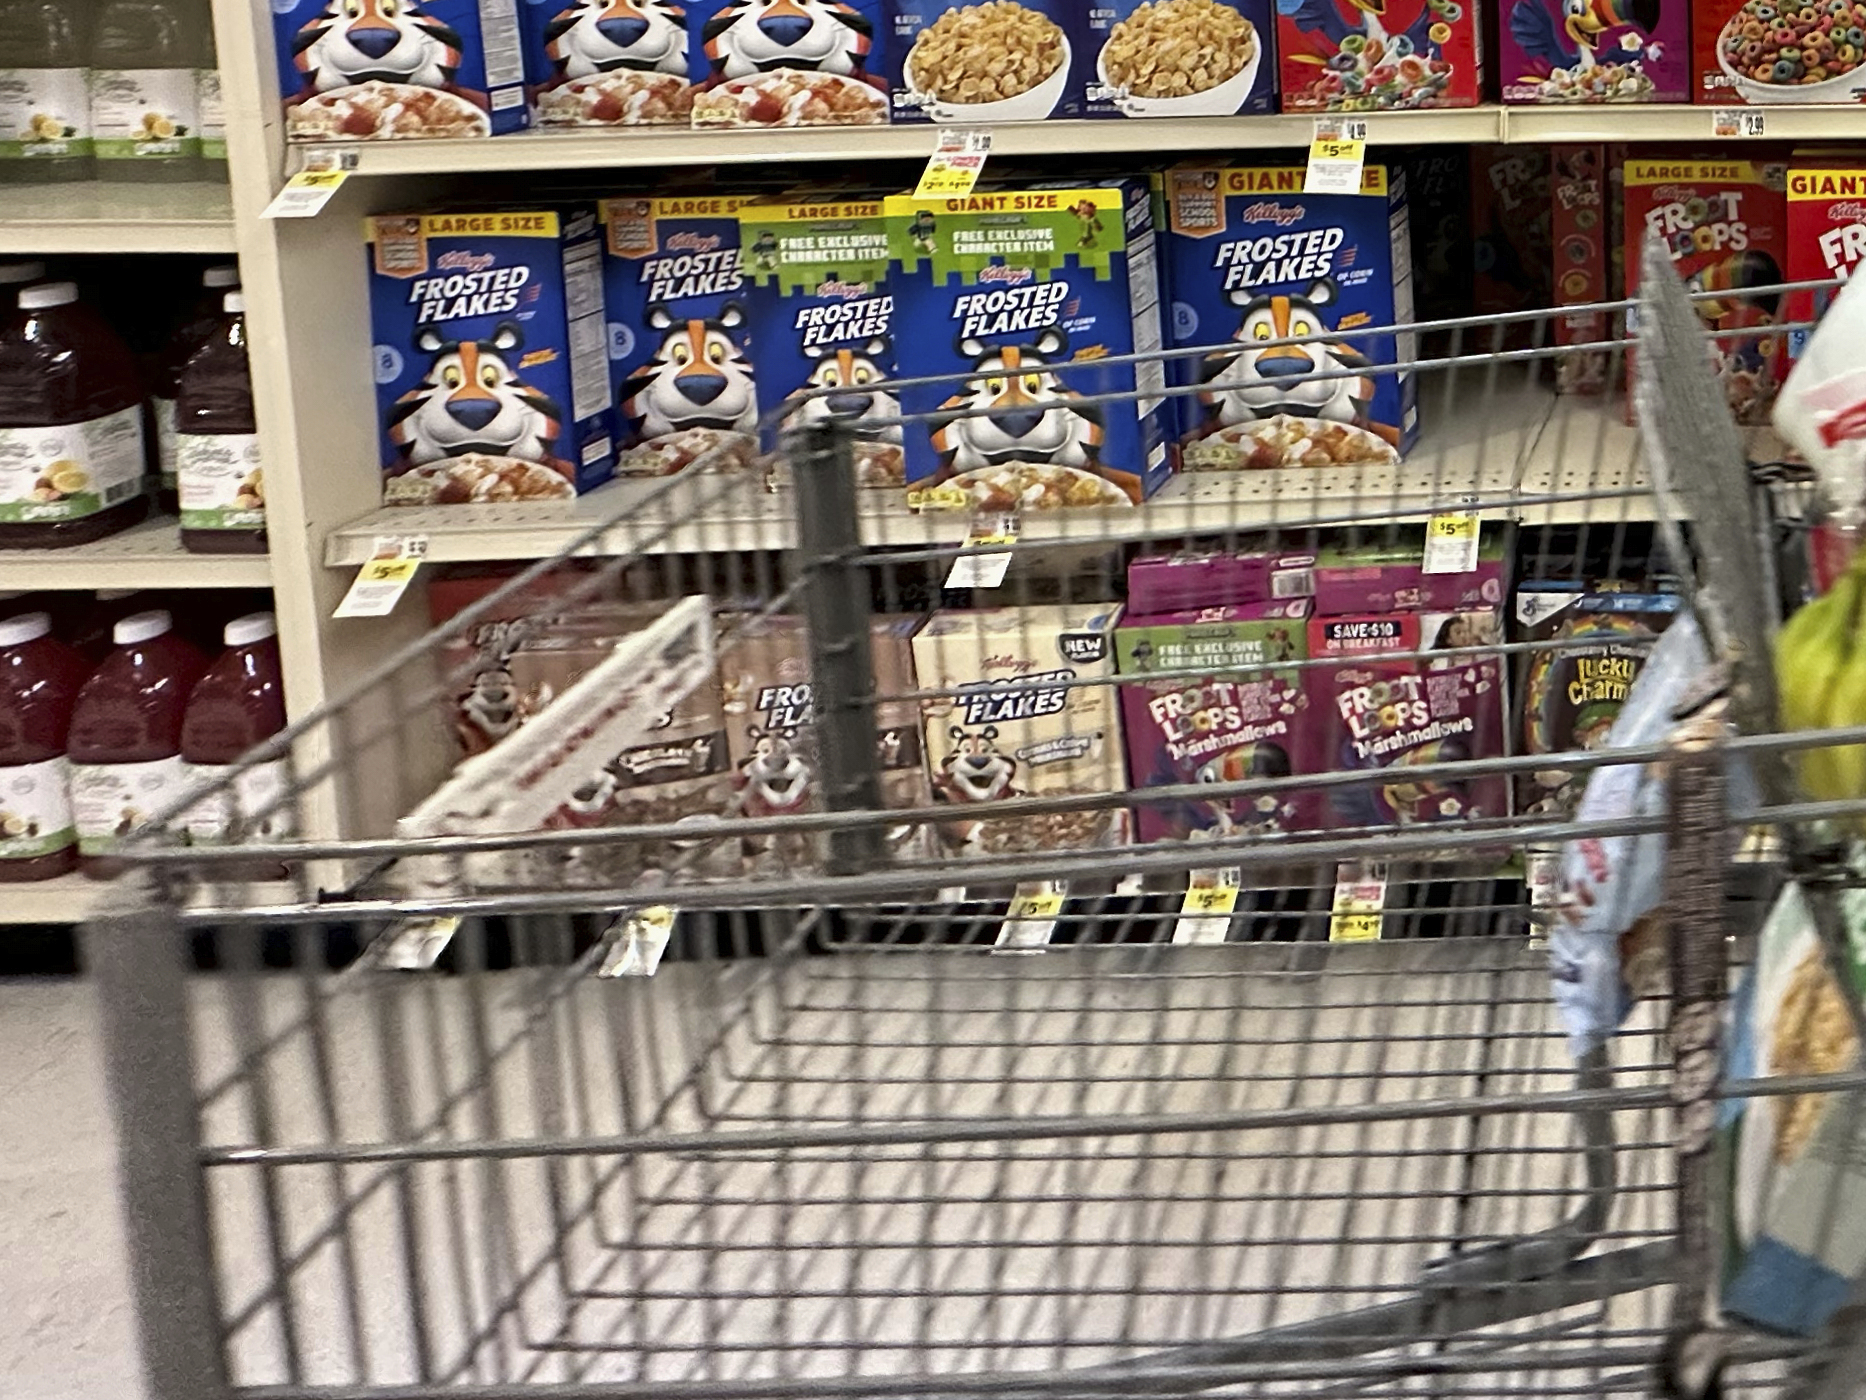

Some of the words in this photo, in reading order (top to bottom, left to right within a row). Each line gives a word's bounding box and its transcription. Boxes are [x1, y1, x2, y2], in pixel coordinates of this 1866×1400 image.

[1322, 144, 1338, 157] $5
[1340, 143, 1354, 155] off
[1228, 171, 1304, 192] GIANT
[659, 201, 721, 215] LARGE
[946, 196, 1007, 212] GIANT
[1014, 194, 1057, 209] SIZE
[1646, 192, 1743, 238] FROOT
[1223, 254, 1335, 290] FLAKES
[418, 290, 519, 323] FLAKES
[953, 282, 1069, 319] FROSTED
[1333, 624, 1367, 637] SAVE
[1372, 622, 1394, 636] $10
[1064, 638, 1100, 654] NEW
[1163, 707, 1242, 740] LOOPS
[1350, 700, 1430, 736] LOOPS
